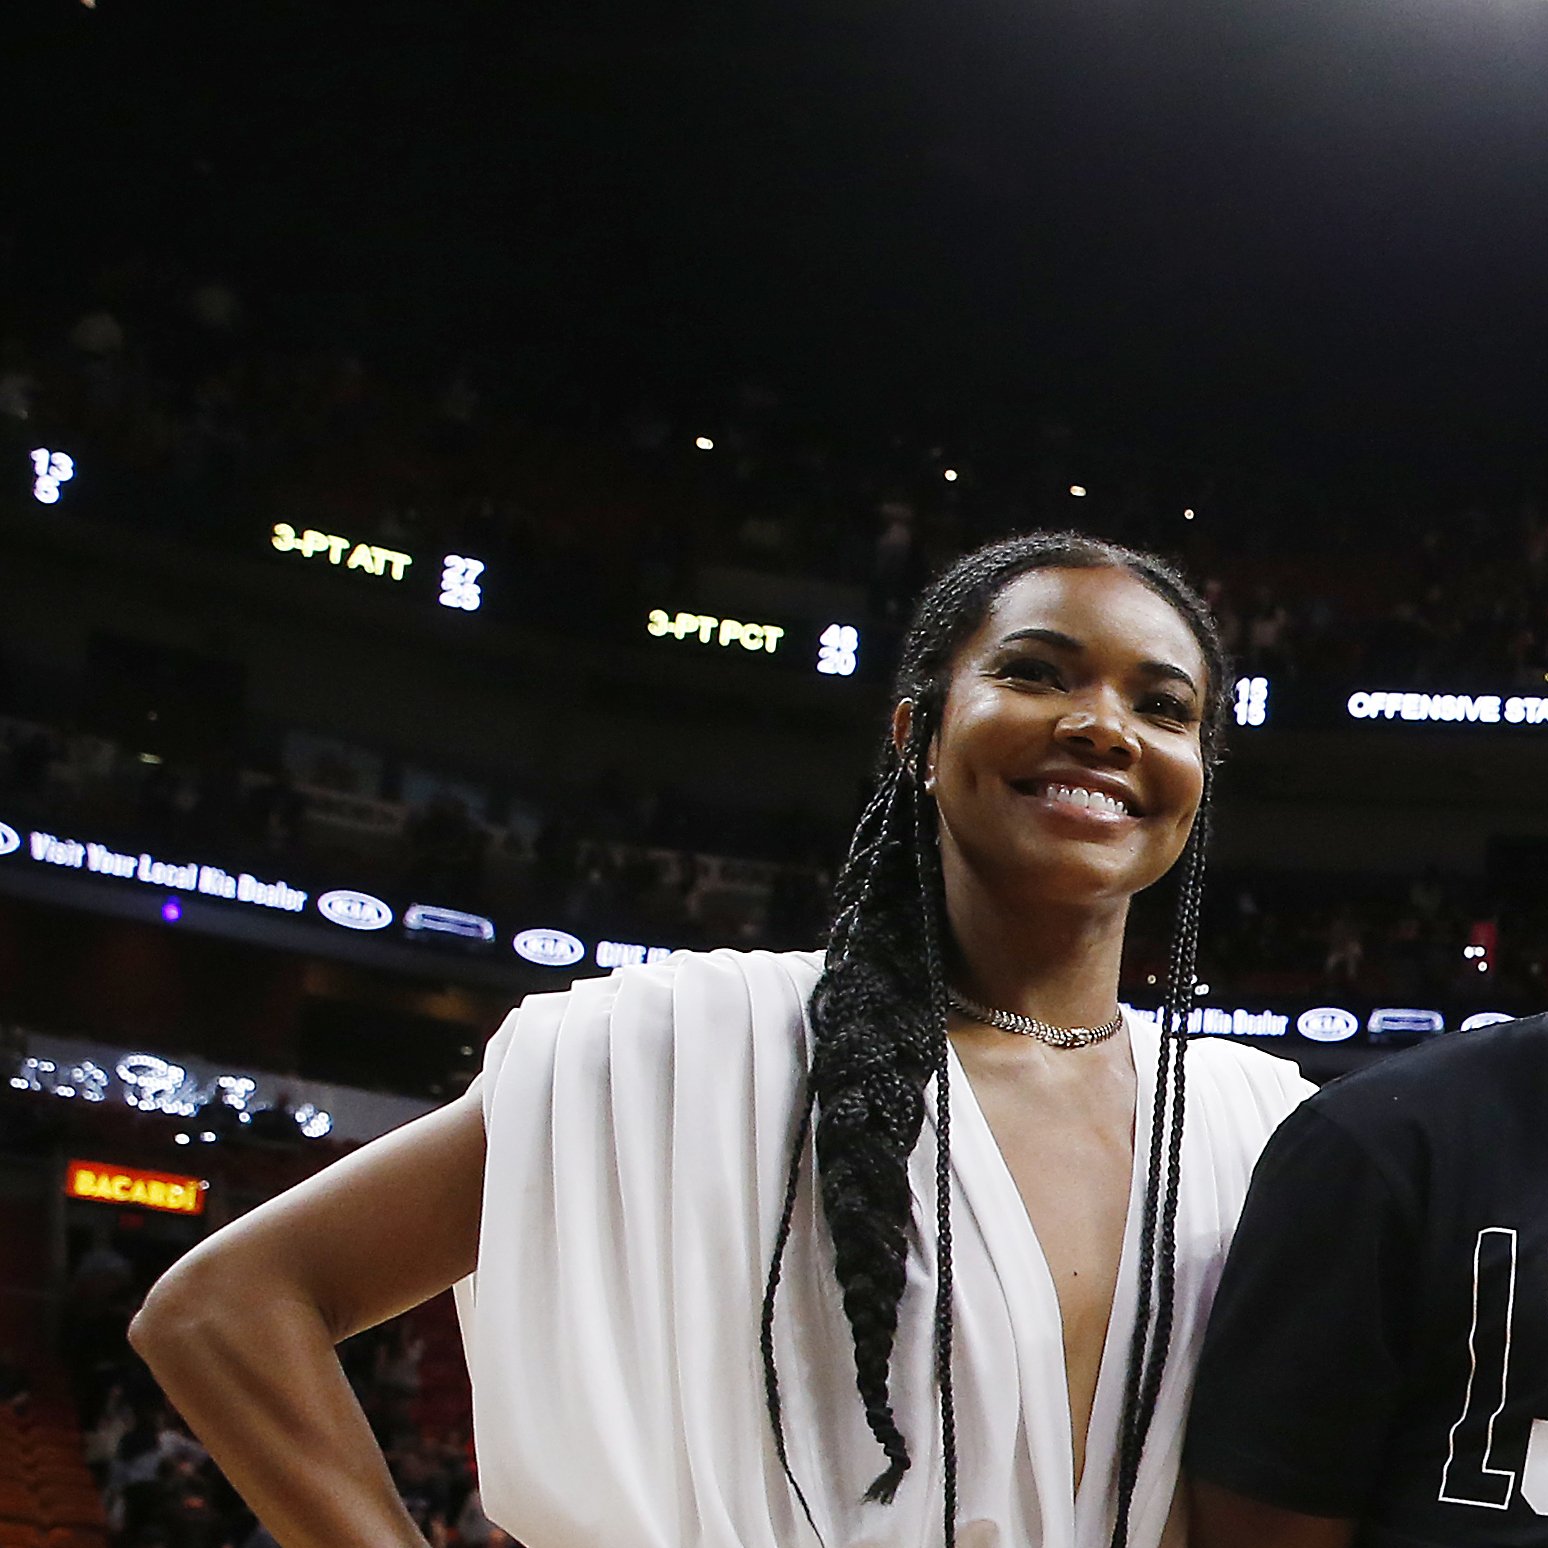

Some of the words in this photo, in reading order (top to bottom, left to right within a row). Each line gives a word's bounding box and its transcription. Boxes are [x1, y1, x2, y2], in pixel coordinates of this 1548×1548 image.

[30, 447, 75, 482] 13
[271, 522, 350, 566] 3-PT
[346, 543, 413, 581] ATT
[647, 608, 718, 644] 3-PT
[718, 619, 784, 654] PCT
[1234, 677, 1268, 703] 15
[1347, 691, 1500, 724] OFFENSIVE
[30, 831, 85, 868] Visit
[86, 842, 137, 878] Your
[138, 853, 199, 891] Local
[198, 865, 237, 899] Kia
[237, 873, 308, 912] Dealer
[1233, 1008, 1289, 1036] Dealer
